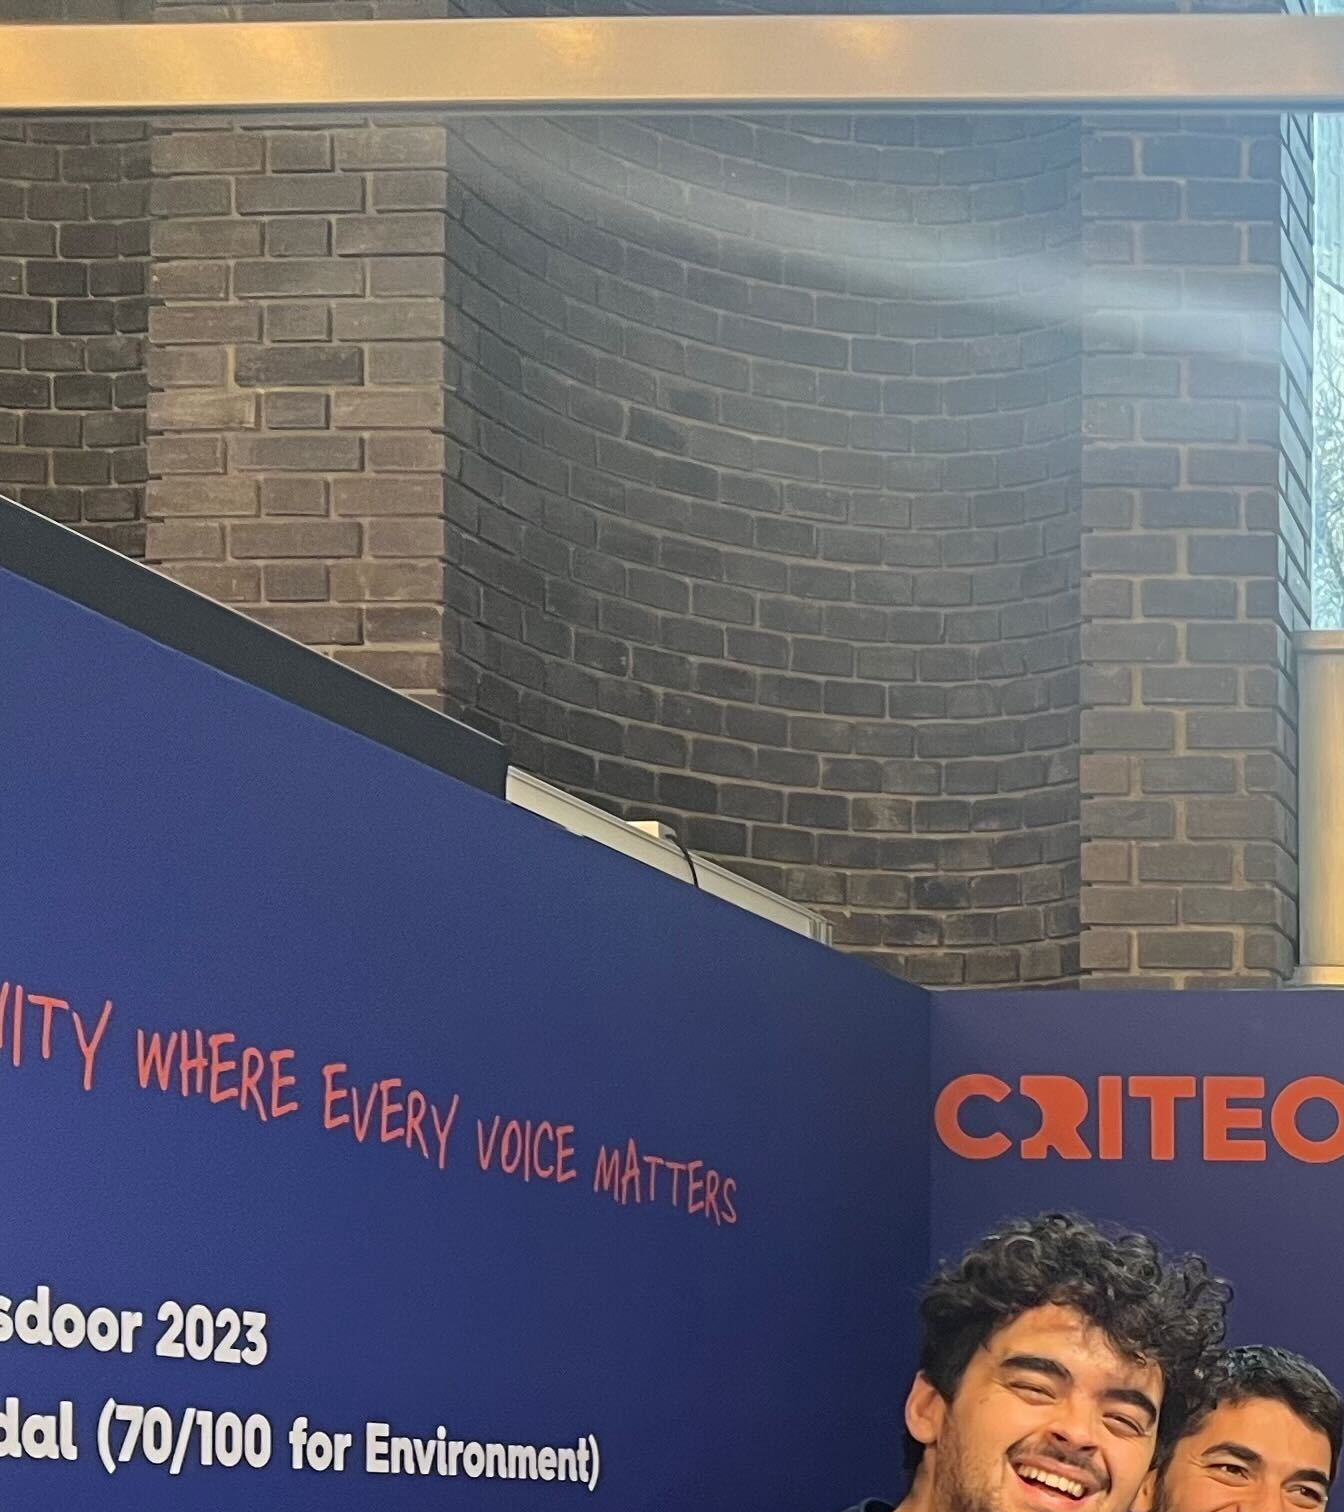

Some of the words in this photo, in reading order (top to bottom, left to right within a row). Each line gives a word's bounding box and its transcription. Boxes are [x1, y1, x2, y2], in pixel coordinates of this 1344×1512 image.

[0, 982, 113, 1091] ITY
[137, 1028, 299, 1122] WHERE
[323, 1062, 459, 1170] EVERY
[477, 1116, 577, 1184] VOICE
[594, 1139, 738, 1225] MATTERS
[156, 1300, 269, 1366] 2023
[97, 1398, 272, 1475] (70/100
[289, 1417, 351, 1472] for
[365, 1421, 600, 1492] Environment)
